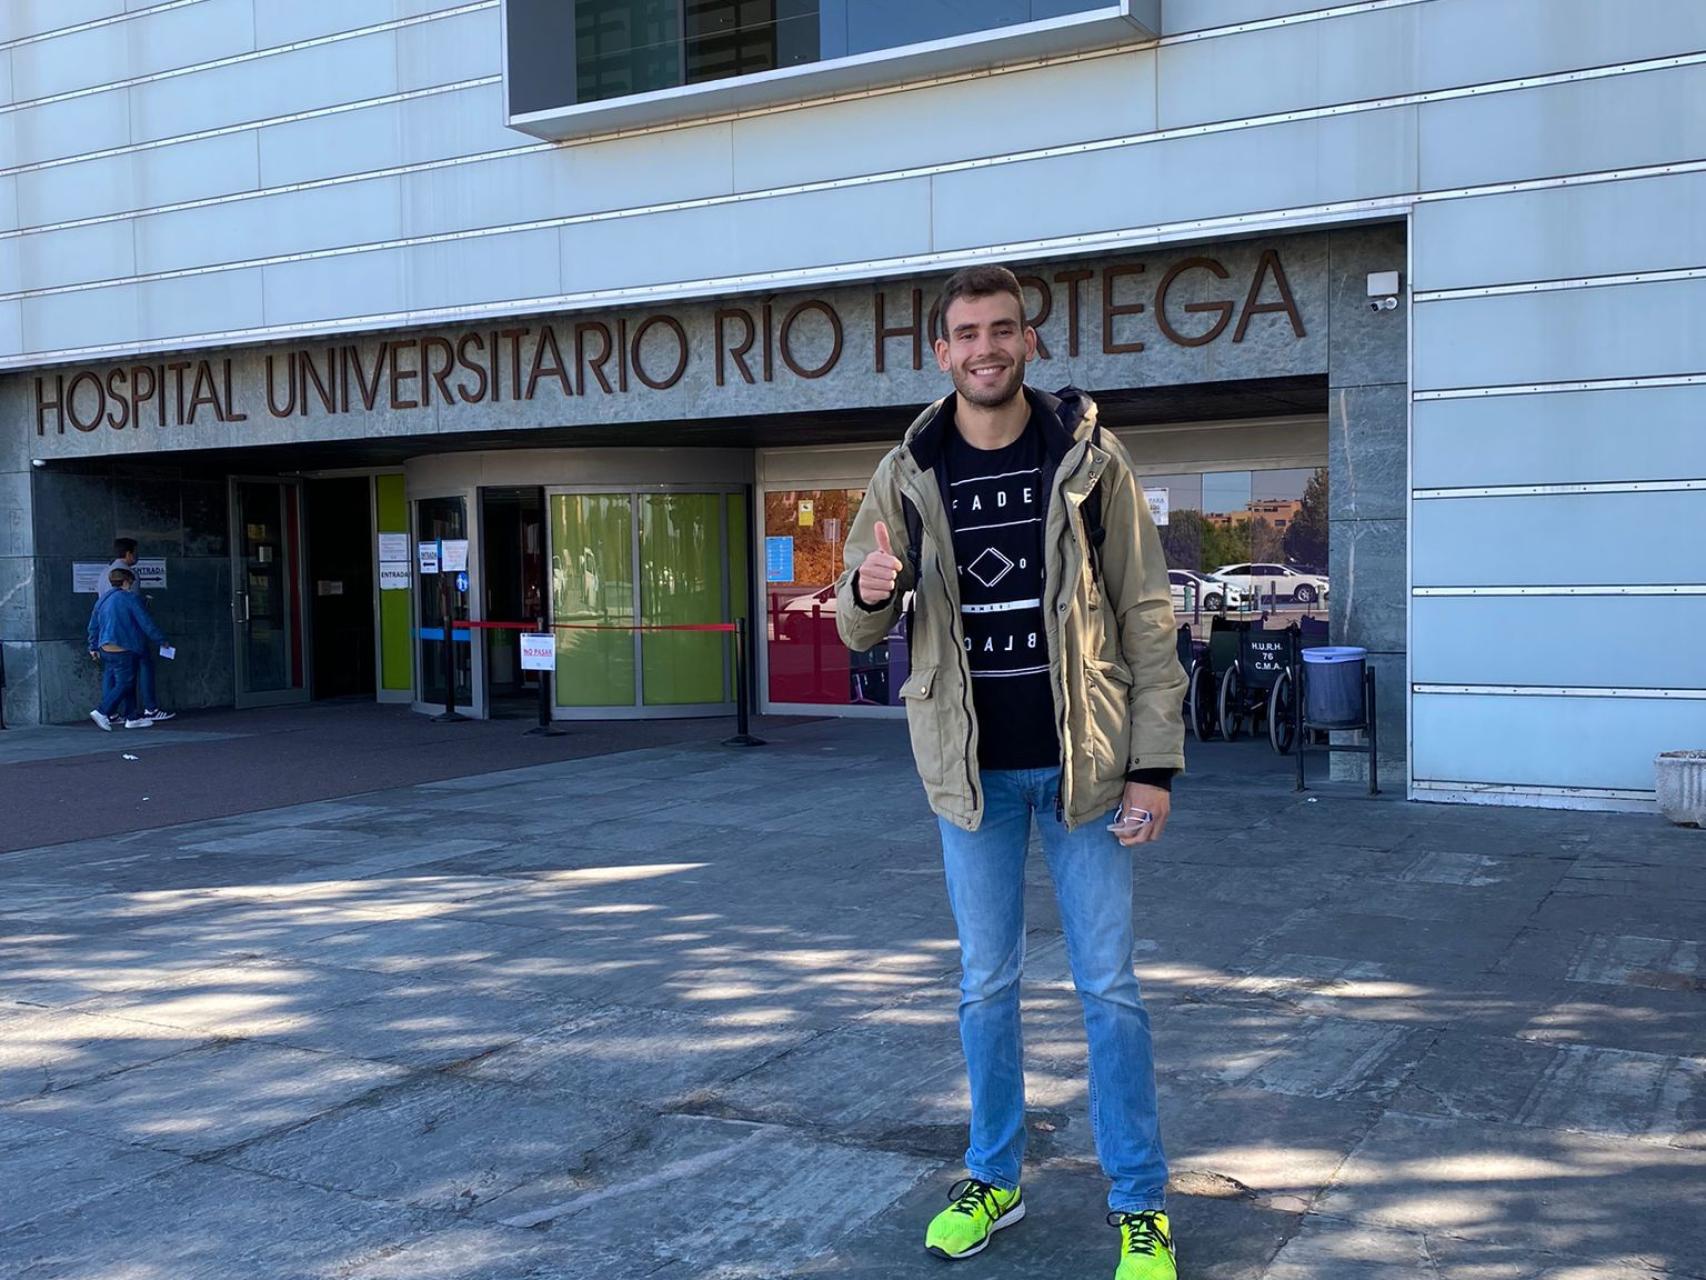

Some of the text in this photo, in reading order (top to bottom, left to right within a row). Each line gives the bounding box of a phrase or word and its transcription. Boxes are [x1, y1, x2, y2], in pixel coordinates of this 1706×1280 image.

[34, 358, 248, 437] HOSPITAL
[265, 315, 689, 418] UNIVERSITARIO
[134, 566, 165, 575] NTRADA
[1262, 652, 1274, 660] 76
